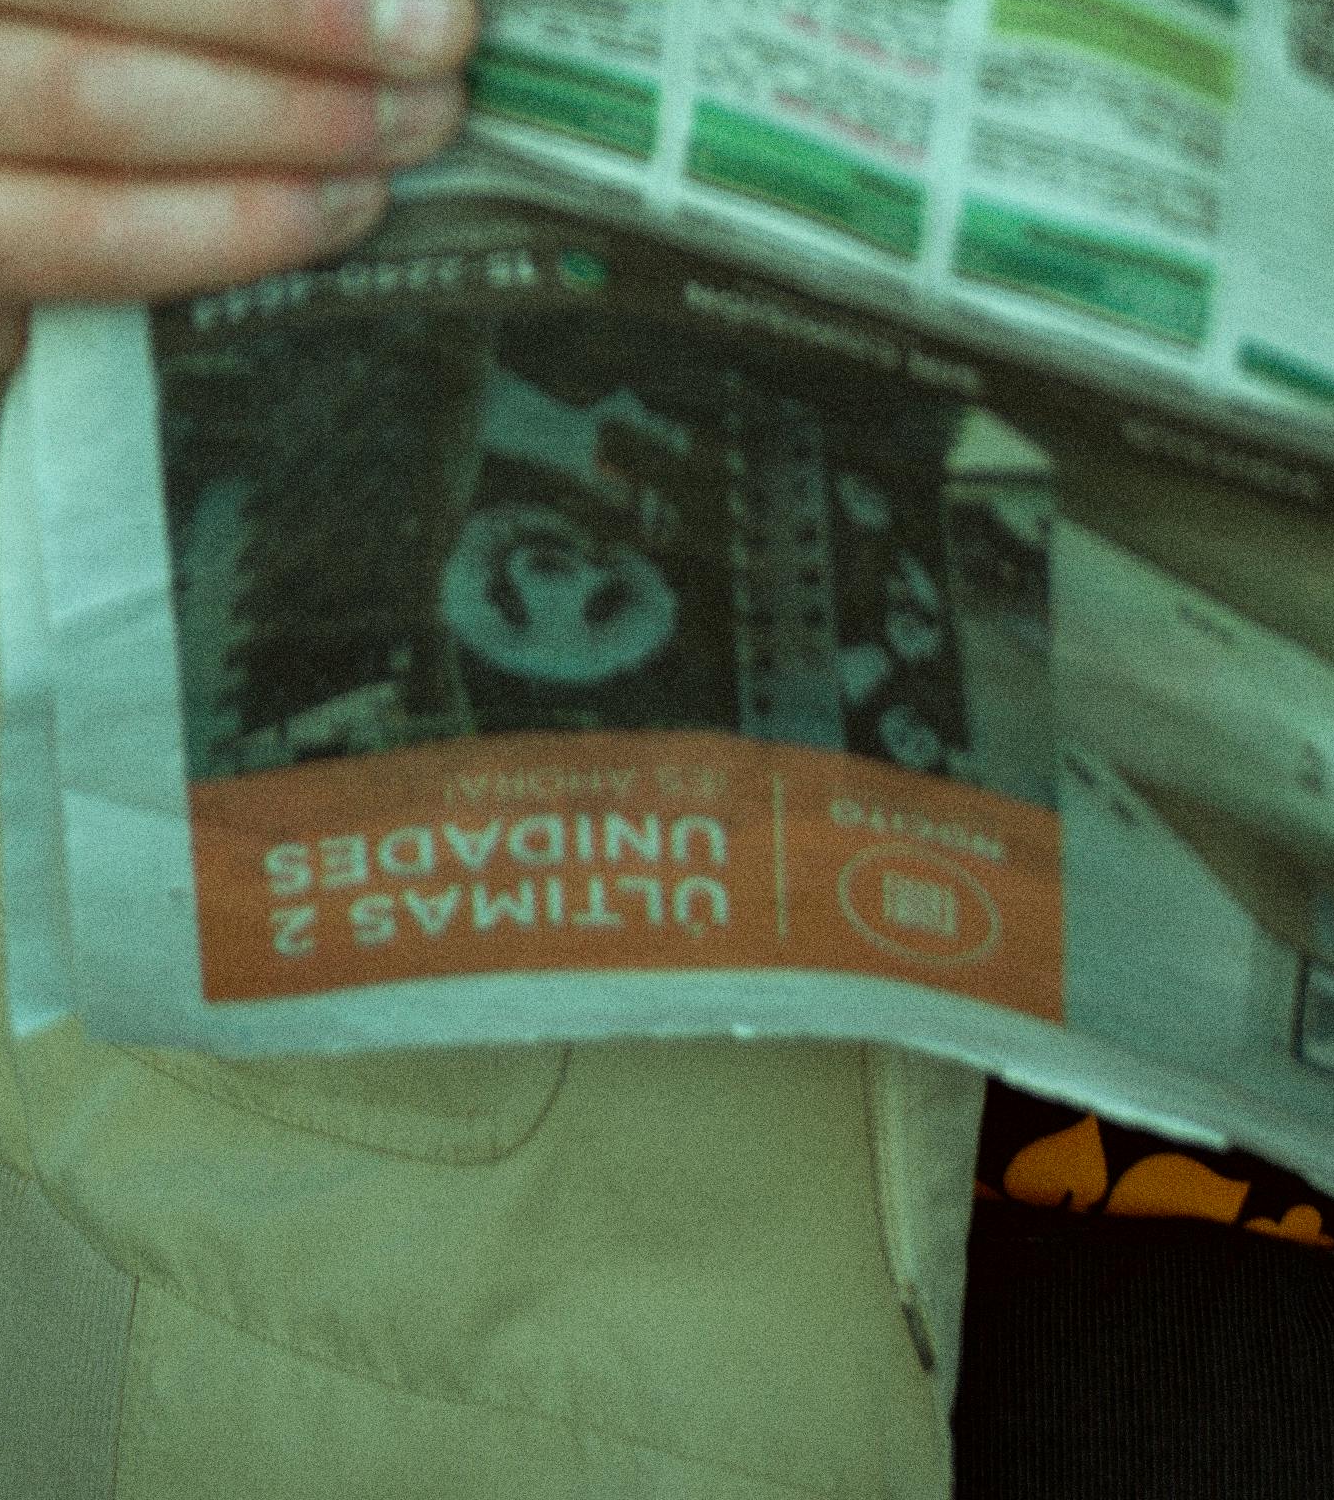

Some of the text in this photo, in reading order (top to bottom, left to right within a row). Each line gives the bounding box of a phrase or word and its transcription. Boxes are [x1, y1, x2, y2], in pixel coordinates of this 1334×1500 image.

[263, 809, 729, 896] UNIDADES
[267, 874, 731, 961] ÚLTIMAS 2
